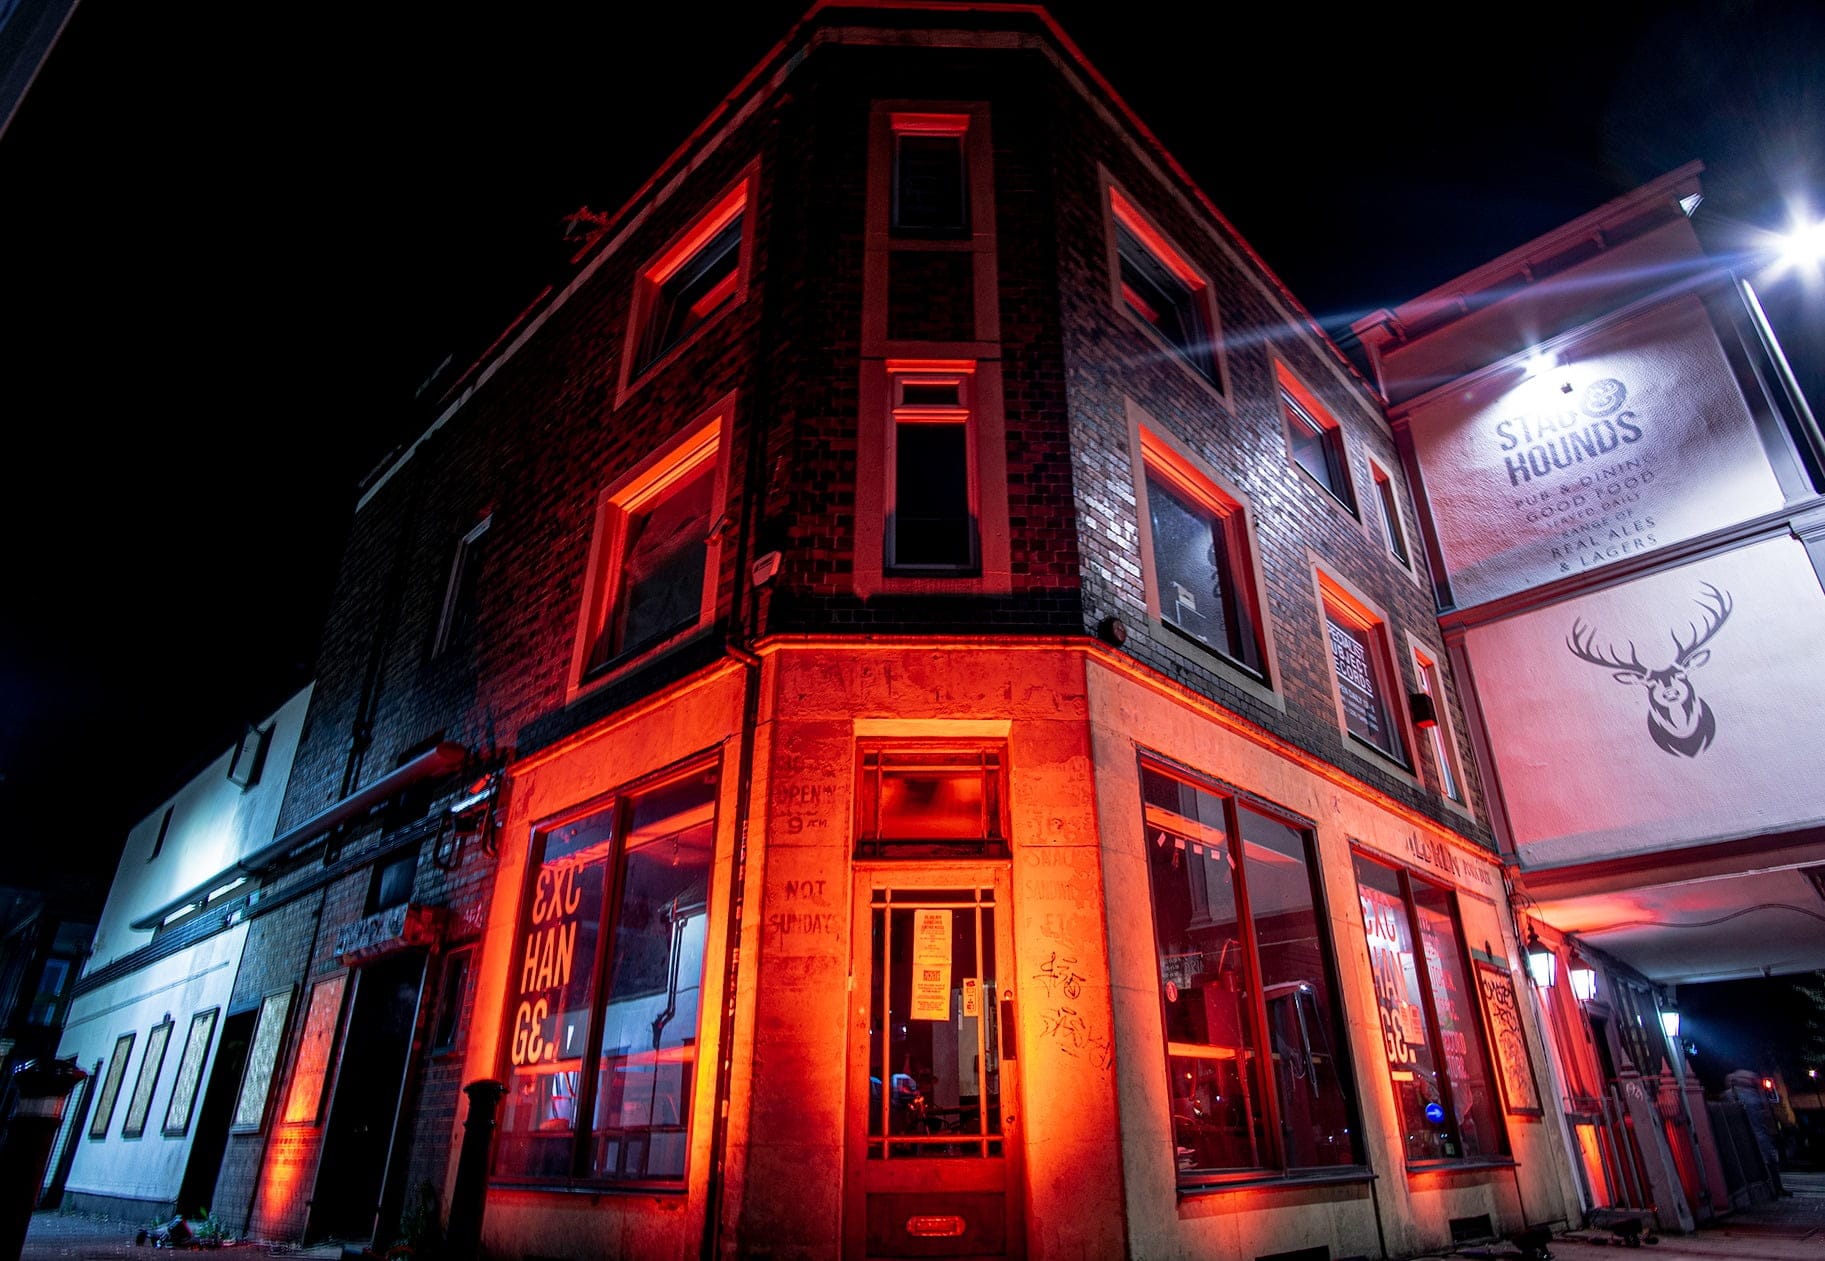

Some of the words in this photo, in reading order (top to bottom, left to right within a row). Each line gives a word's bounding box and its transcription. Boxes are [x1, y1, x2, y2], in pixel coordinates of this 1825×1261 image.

[1504, 411, 1642, 486] HOUNDS
[1526, 495, 1586, 523] GOOD
[1595, 471, 1655, 498] FOOD
[1614, 509, 1633, 522] OF
[1551, 536, 1600, 559] REAL
[1608, 517, 1657, 541] ALES
[1560, 561, 1570, 573] &
[1580, 534, 1658, 567] LAGERS
[1332, 640, 1369, 678] UBJECT
[1335, 656, 1373, 693] ECORDS
[532, 862, 584, 925] EXC
[785, 880, 826, 900] NOT
[520, 921, 577, 995] HAN
[1373, 946, 1410, 1005] HAN
